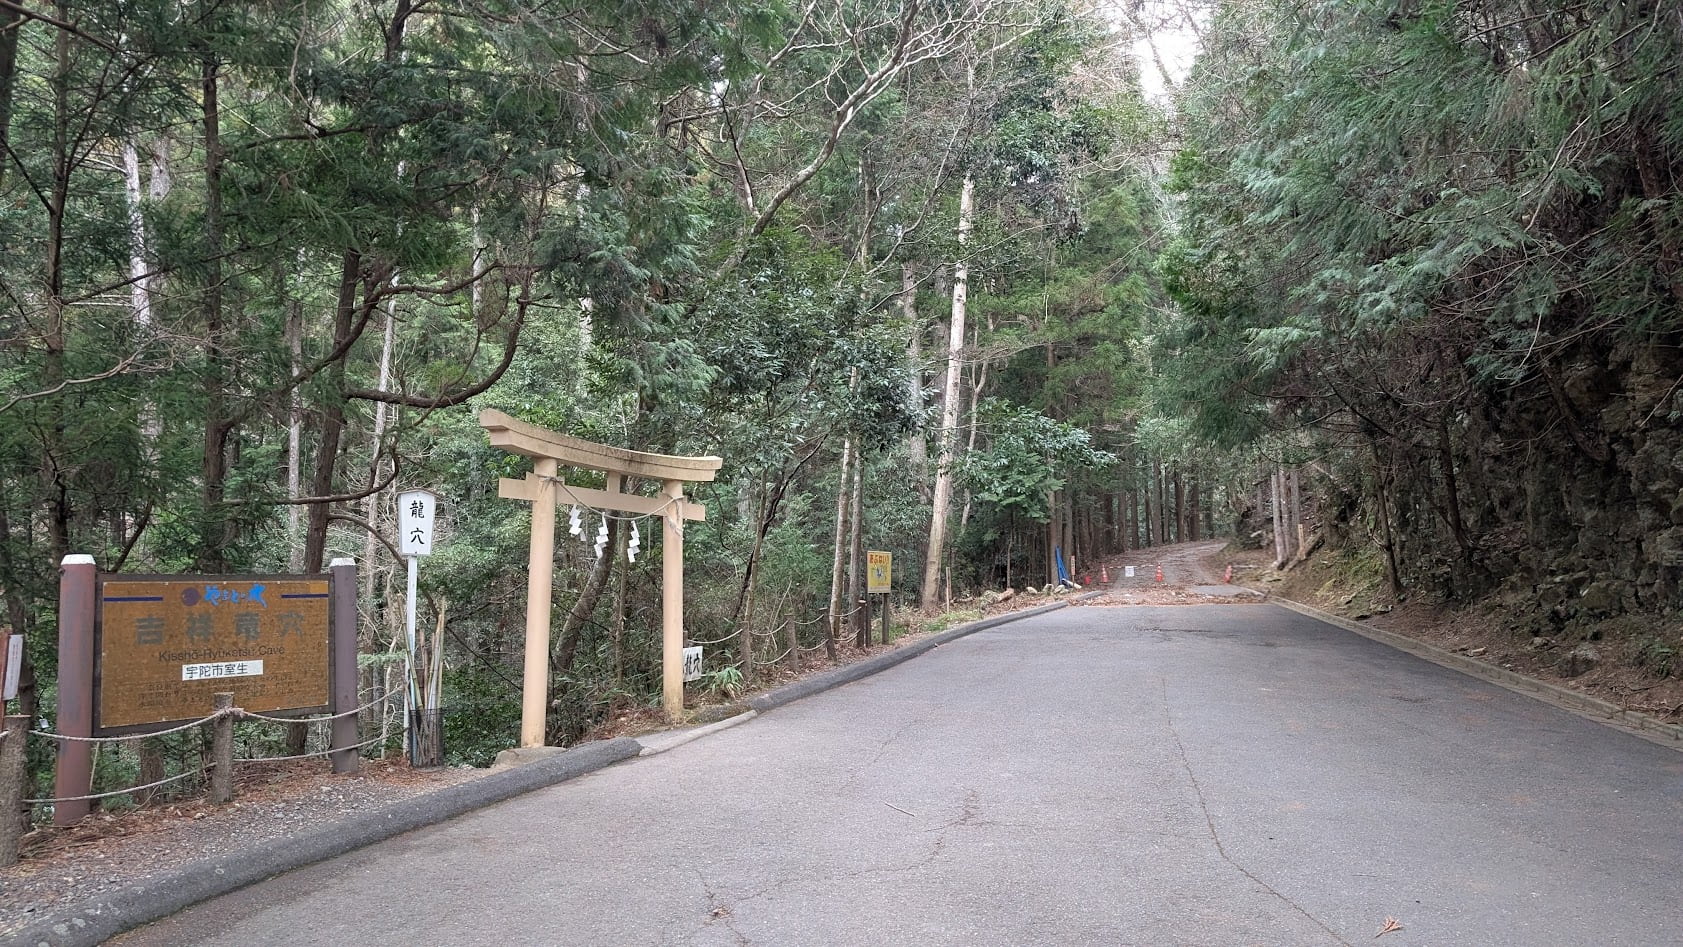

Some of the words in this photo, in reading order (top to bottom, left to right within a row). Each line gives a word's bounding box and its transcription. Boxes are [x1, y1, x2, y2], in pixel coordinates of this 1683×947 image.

[409, 500, 425, 544] 龍穴
[258, 645, 285, 656] Cave
[186, 663, 248, 679] 宇陀市室生
